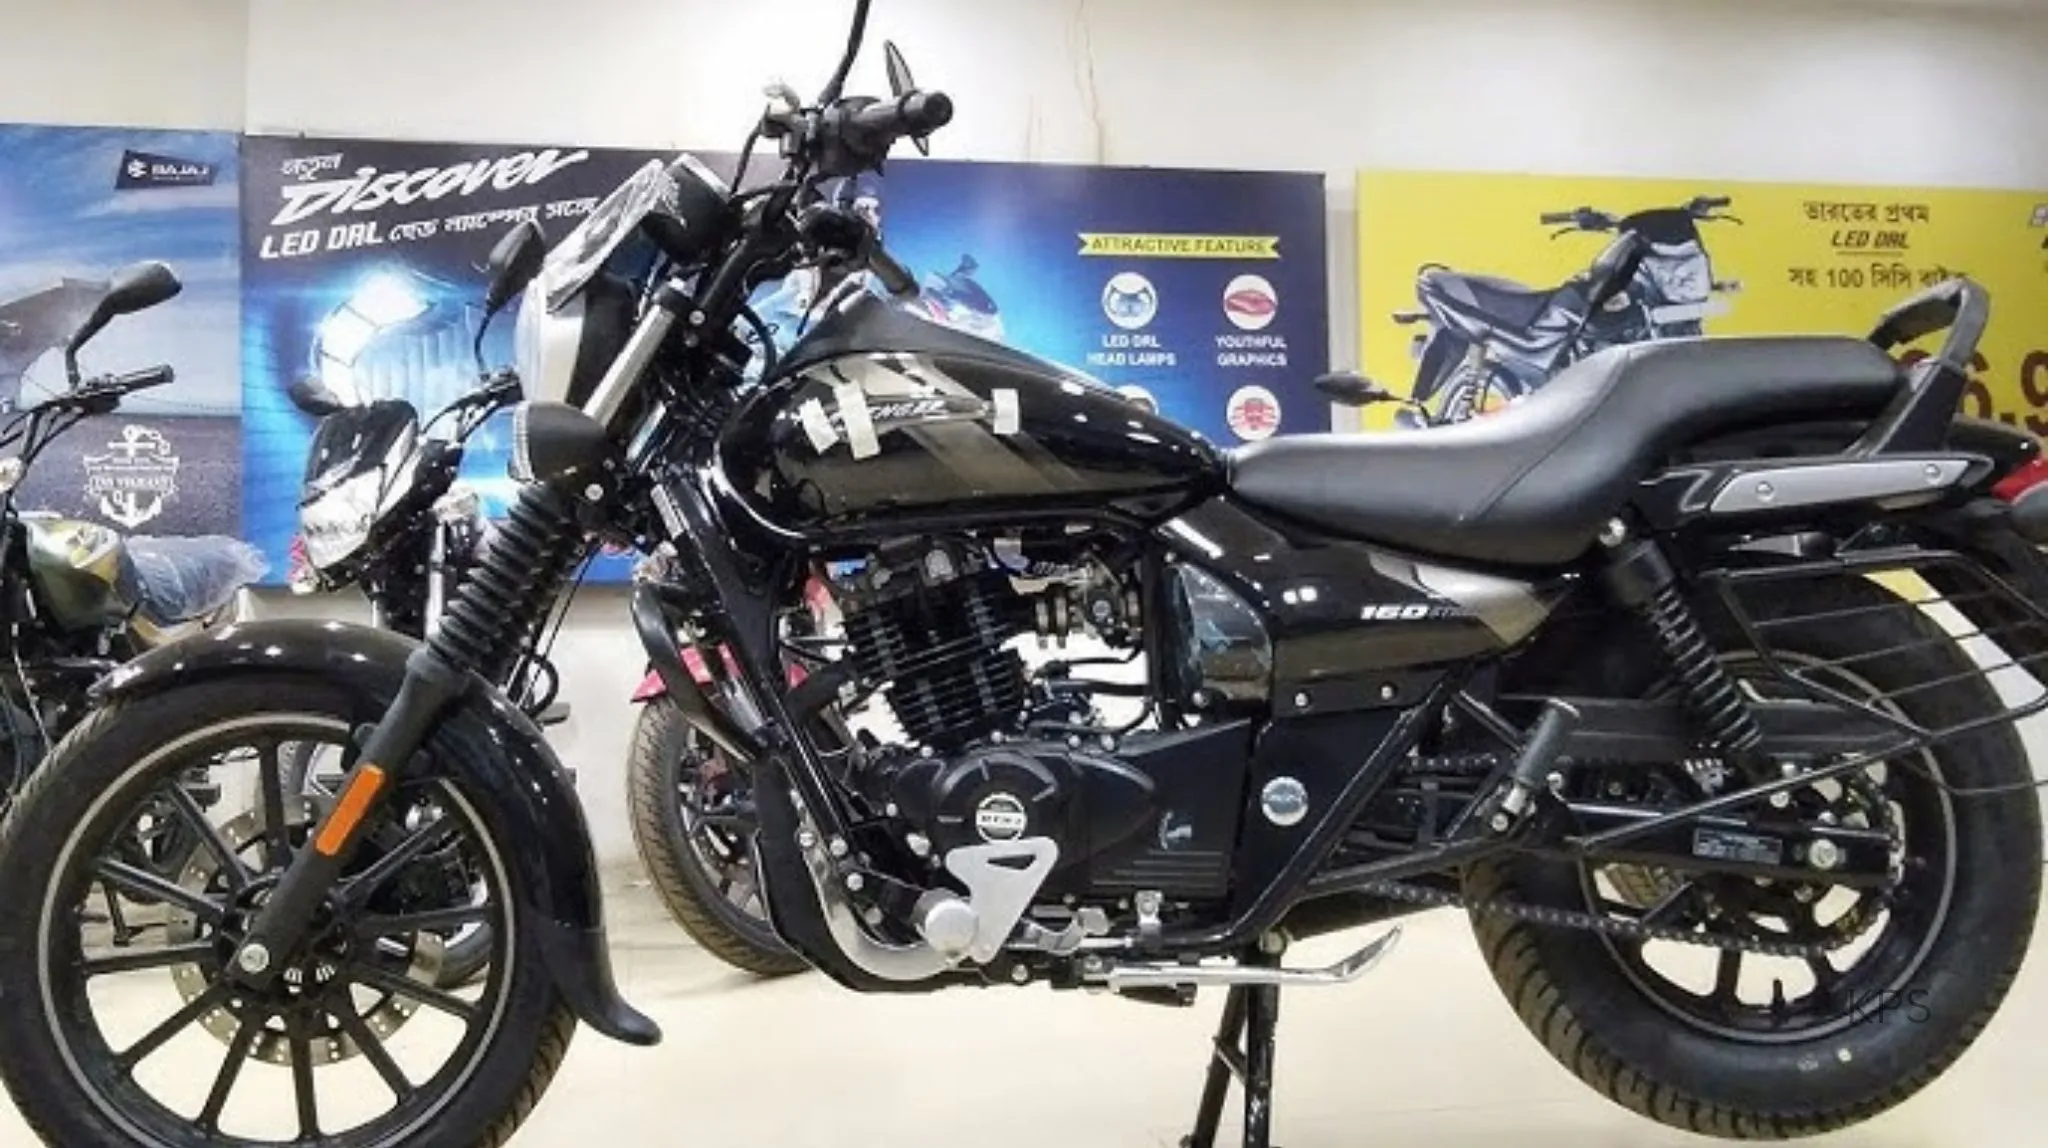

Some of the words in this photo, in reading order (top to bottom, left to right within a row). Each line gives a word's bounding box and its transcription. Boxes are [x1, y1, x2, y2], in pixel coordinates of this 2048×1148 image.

[152, 164, 210, 175] BAJAJ
[1803, 201, 1878, 222] ভারতের
[1885, 202, 1930, 224] প্রথম
[260, 231, 319, 259] LED
[327, 221, 383, 250] DRL
[1091, 236, 1189, 253] ATTRACTIVE
[1194, 238, 1266, 255] FEATURE
[1831, 230, 1870, 248] LED
[1873, 231, 1910, 249] DRL
[1788, 268, 1818, 287] সহ
[1827, 268, 1864, 288] 100
[1871, 263, 1911, 289] সিসি
[1102, 335, 1129, 348] LED
[1214, 335, 1287, 349] YOUTHFUL
[1086, 353, 1126, 366] HEAD
[1128, 353, 1176, 367] LAMPS
[1216, 352, 1287, 368] GRAPHICS
[1361, 604, 1429, 620] 160
